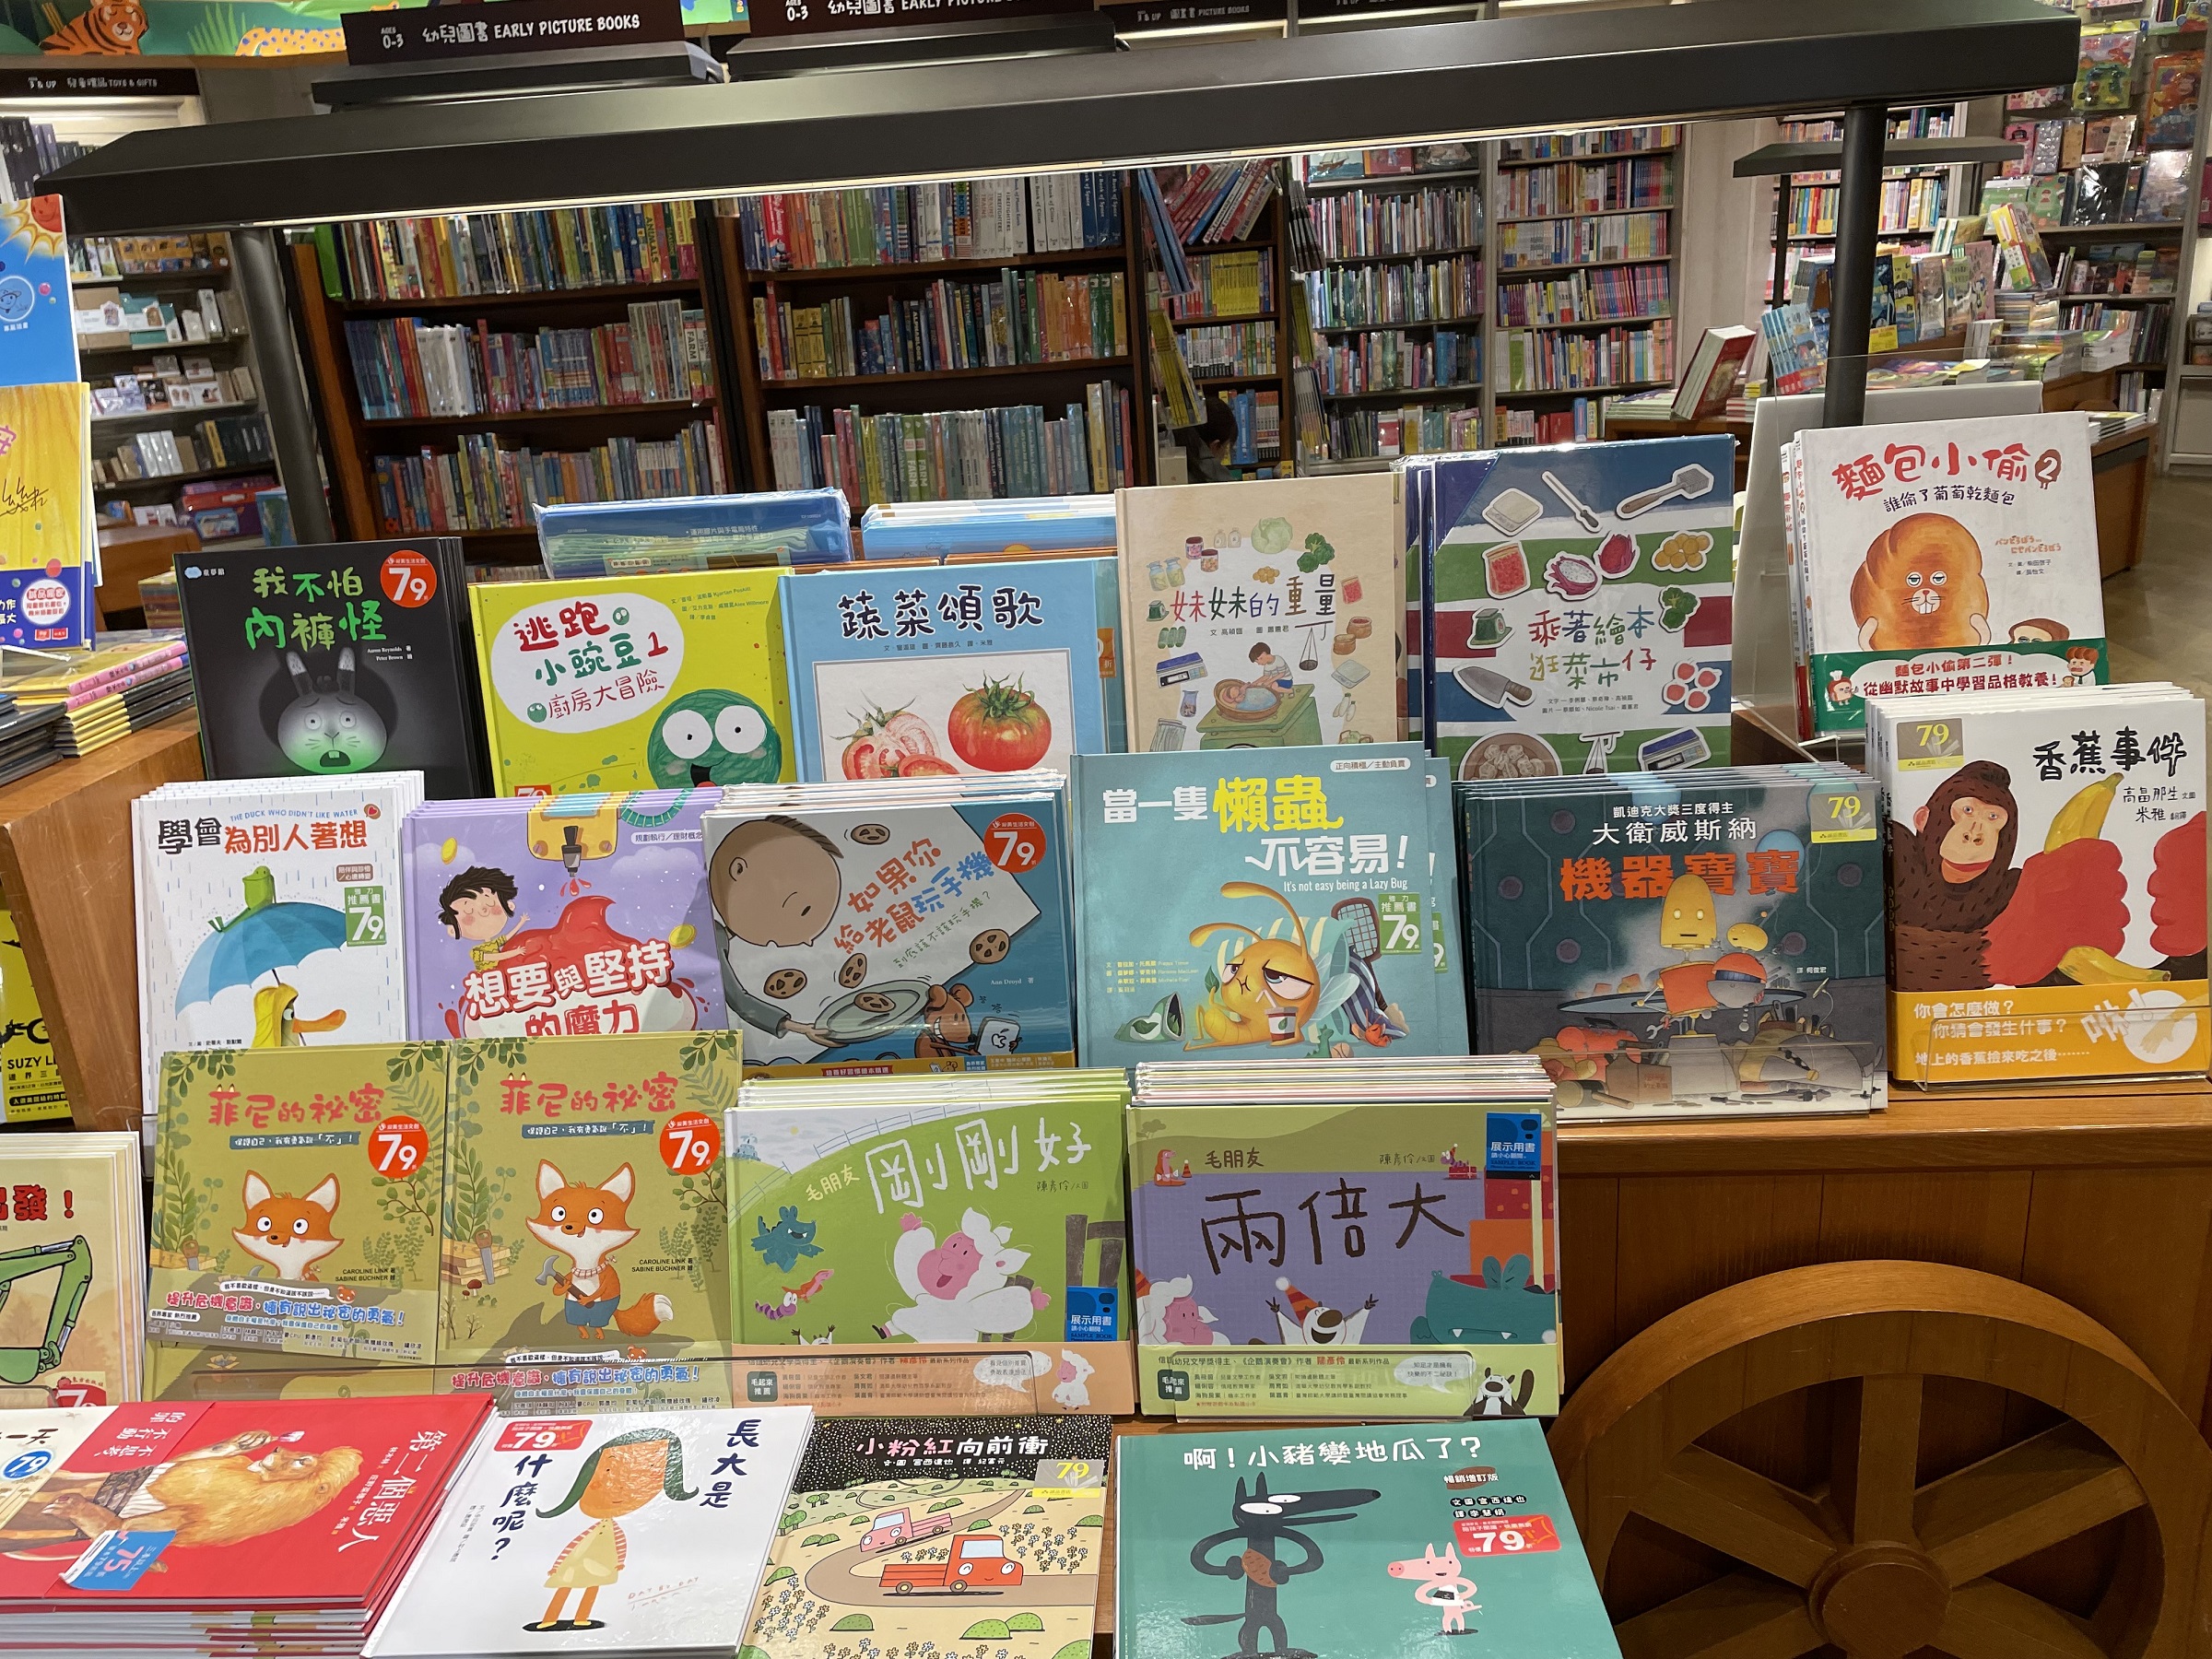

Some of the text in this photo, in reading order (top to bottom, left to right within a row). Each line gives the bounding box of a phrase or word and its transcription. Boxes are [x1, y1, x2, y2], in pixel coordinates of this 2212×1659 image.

[494, 20, 535, 40] EARLY
[538, 17, 594, 36] PICTURE
[596, 14, 641, 30] BOOKS
[786, 6, 808, 21] 0-3
[382, 34, 404, 49] 0-3
[46, 80, 56, 89] UP
[109, 78, 127, 88] TOYS
[136, 77, 158, 88] GIFTS
[645, 215, 659, 265] ANIMALS
[687, 331, 698, 360] FARM
[908, 460, 918, 488] FARM
[918, 459, 927, 488] FARM
[1831, 441, 2058, 501] 麵包小偷 2
[1883, 485, 2016, 513] 誰偷了葡萄乾麵包
[252, 566, 365, 604] 我不怕
[388, 567, 428, 601] 79
[1170, 573, 1337, 623] 妹妹的重量
[244, 599, 388, 653] 內褲怪
[513, 601, 611, 652] 逃跑
[836, 583, 1045, 641] 蔬菜頌歌
[1527, 605, 1655, 647] 乘著繪本
[1209, 629, 1218, 637] 文
[535, 631, 669, 687] 小豌豆 1
[1529, 648, 1657, 690] 逛菜市仔
[1894, 653, 2014, 678] 麵包小偷第二彈！
[548, 668, 665, 720] 廚房大冒險
[1863, 672, 2058, 698] 從幽默故事中學習品格教養！
[1916, 723, 1949, 747] 79
[2032, 726, 2188, 782] 香蕉事件
[229, 807, 359, 823] THE DUCK WHO DIDN'T LIKE WATER
[1102, 774, 1344, 833] 當一隻 懶蟲
[1612, 801, 1735, 818] 凱迪克大獎三度得主
[1827, 795, 1861, 818] 79
[2136, 806, 2166, 822] 米雅
[158, 817, 368, 855] 學會 為別人著想
[993, 830, 1035, 866] 79
[1592, 817, 1757, 846] 大衛威斯納
[1245, 835, 1409, 877] 不容易！
[848, 838, 942, 914] 如果你
[1284, 877, 1408, 894] It's not easy being a Lazy Bug
[1559, 848, 1801, 902] 機器寶寶
[833, 852, 995, 955] 給老鼠玩手機
[348, 906, 384, 941] 79
[1382, 914, 1419, 949] 79
[465, 940, 672, 1018] 想要與堅持
[1004, 977, 1022, 987] Droyd
[1913, 1000, 2015, 1019] 你會怎麼做？
[7, 1056, 41, 1069] SUZY
[208, 1083, 385, 1129] 菲尼的祕密
[500, 1072, 679, 1117] 菲尼的祕密
[377, 1134, 418, 1172] 79
[668, 1128, 710, 1169] 79
[1205, 1147, 1265, 1169] 毛朋友
[1490, 1141, 1535, 1153] 展示用書
[865, 1116, 1092, 1214] 剛剛好
[805, 1163, 861, 1203] 毛朋友
[1201, 1178, 1465, 1276] 兩倍大
[1071, 1314, 1112, 1326] 展示用書
[750, 1378, 774, 1387] 毛起來
[753, 1387, 771, 1396] 推薦
[116, 1427, 169, 1441] 不行動
[512, 1431, 557, 1450] 79
[855, 1435, 1050, 1457] 小粉紅向前衝
[698, 1418, 763, 1509] 長大是
[1183, 1435, 1483, 1471] 啊！小豬變地瓜了？
[1054, 1461, 1090, 1480] 79
[337, 1428, 449, 1553] 第二個惡人
[490, 1453, 553, 1561] 什麼呢？
[1472, 1530, 1525, 1553] 79
[103, 1546, 146, 1572] 75
